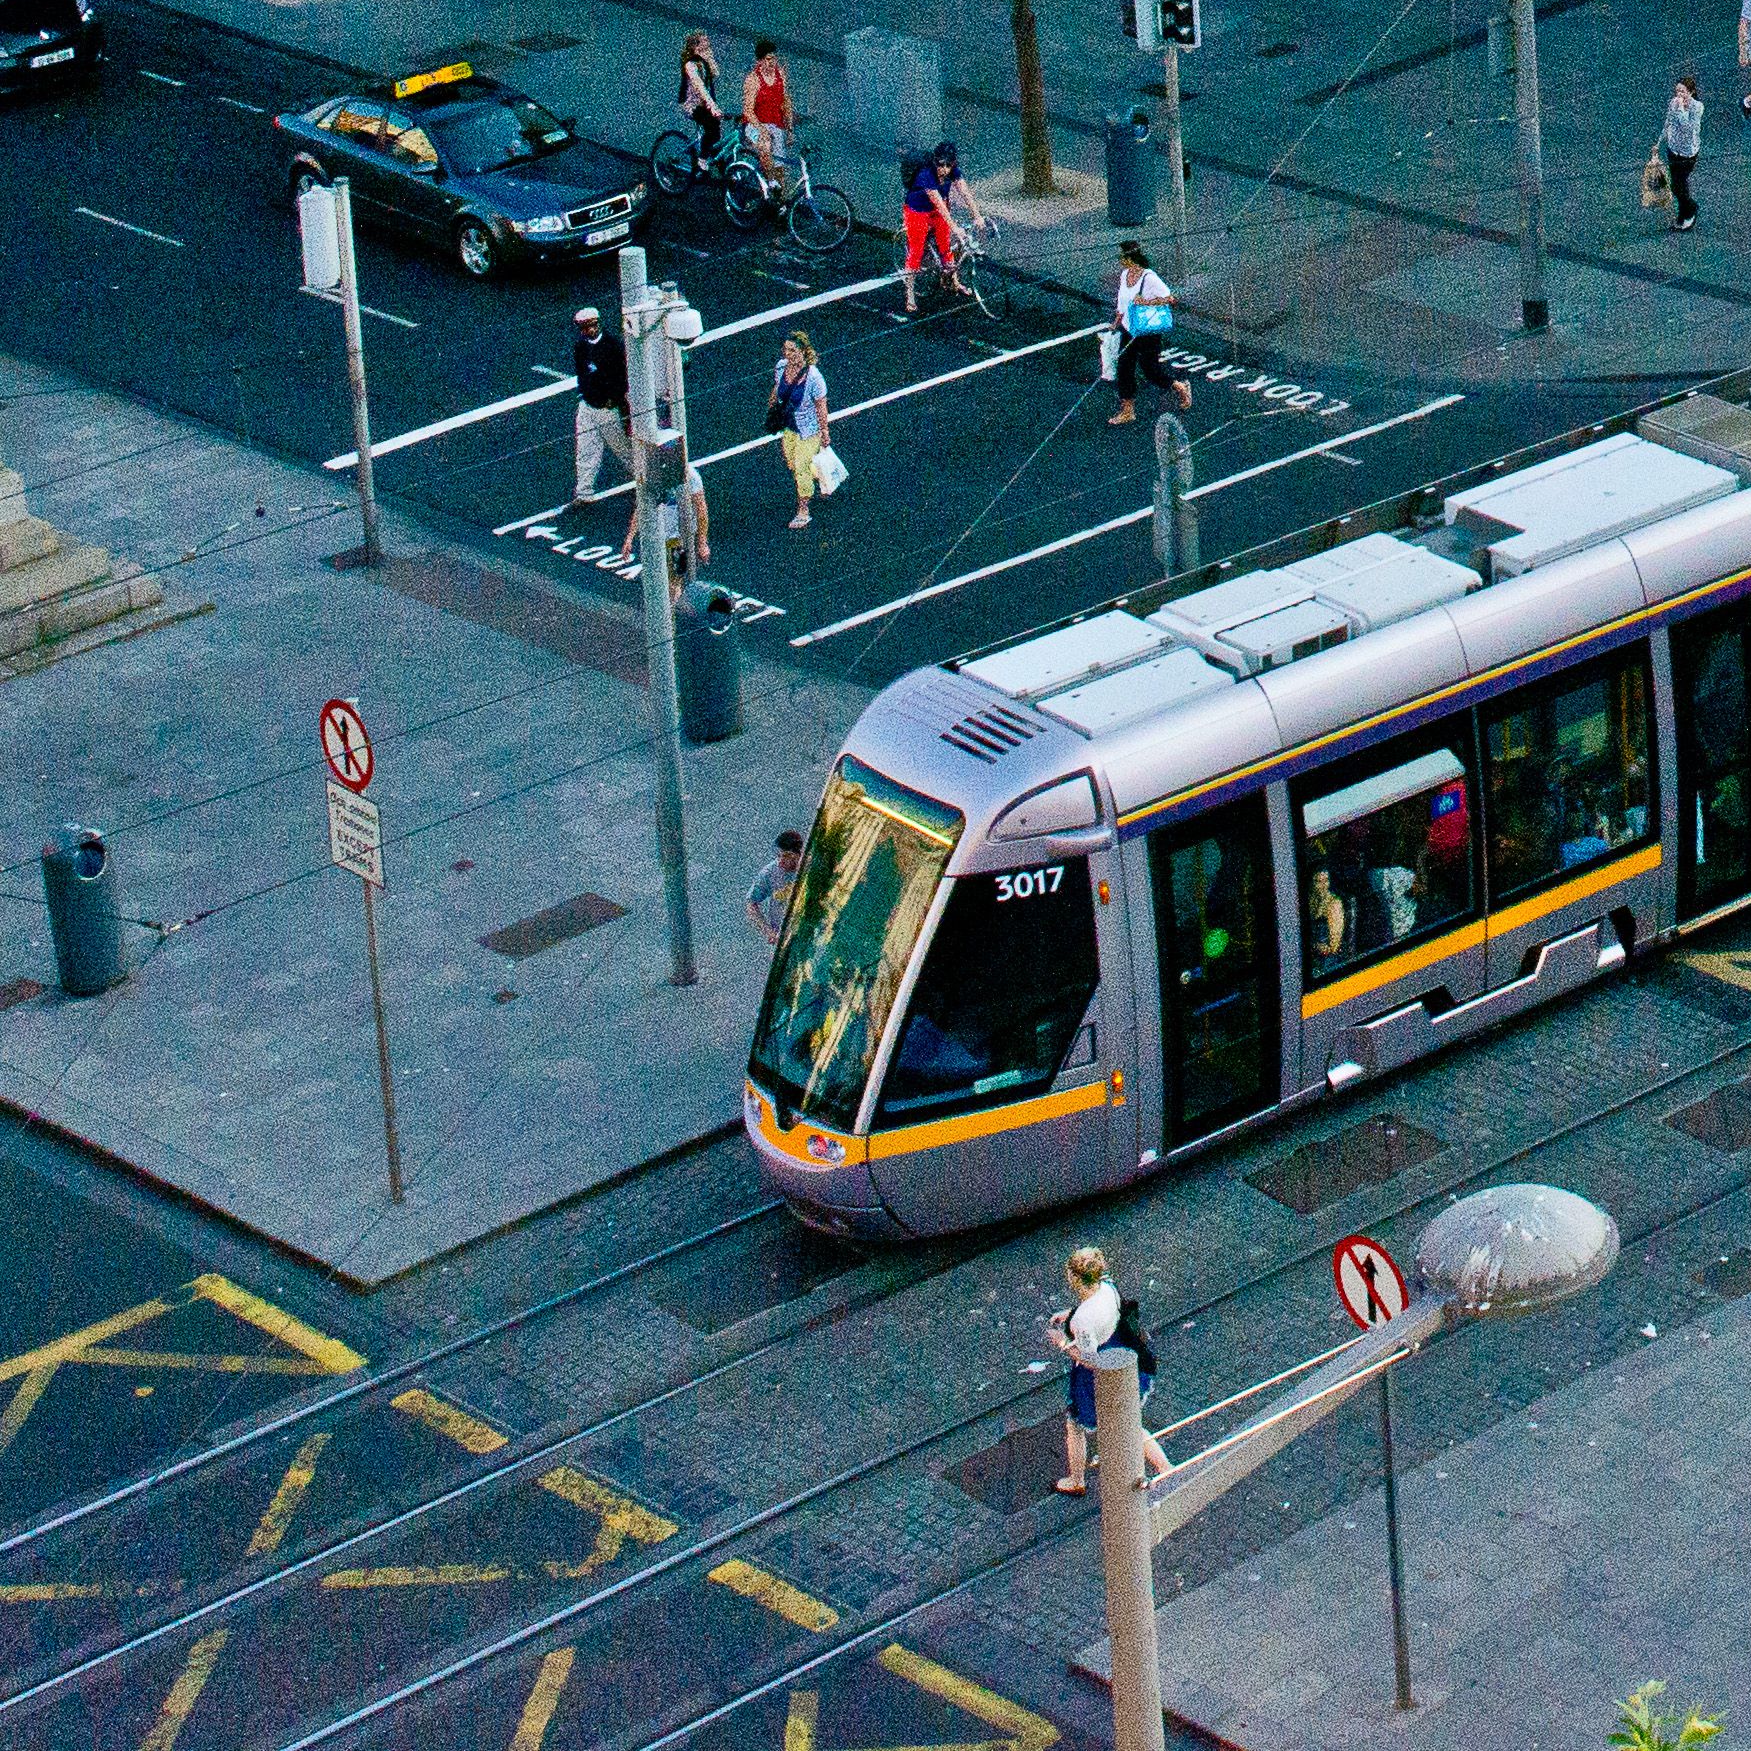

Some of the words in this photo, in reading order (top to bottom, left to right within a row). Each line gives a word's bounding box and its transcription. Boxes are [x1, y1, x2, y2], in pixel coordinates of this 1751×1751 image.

[1157, 347, 1245, 382] RIGH
[1238, 374, 1351, 417] LOOK
[995, 865, 1065, 902] 3017
